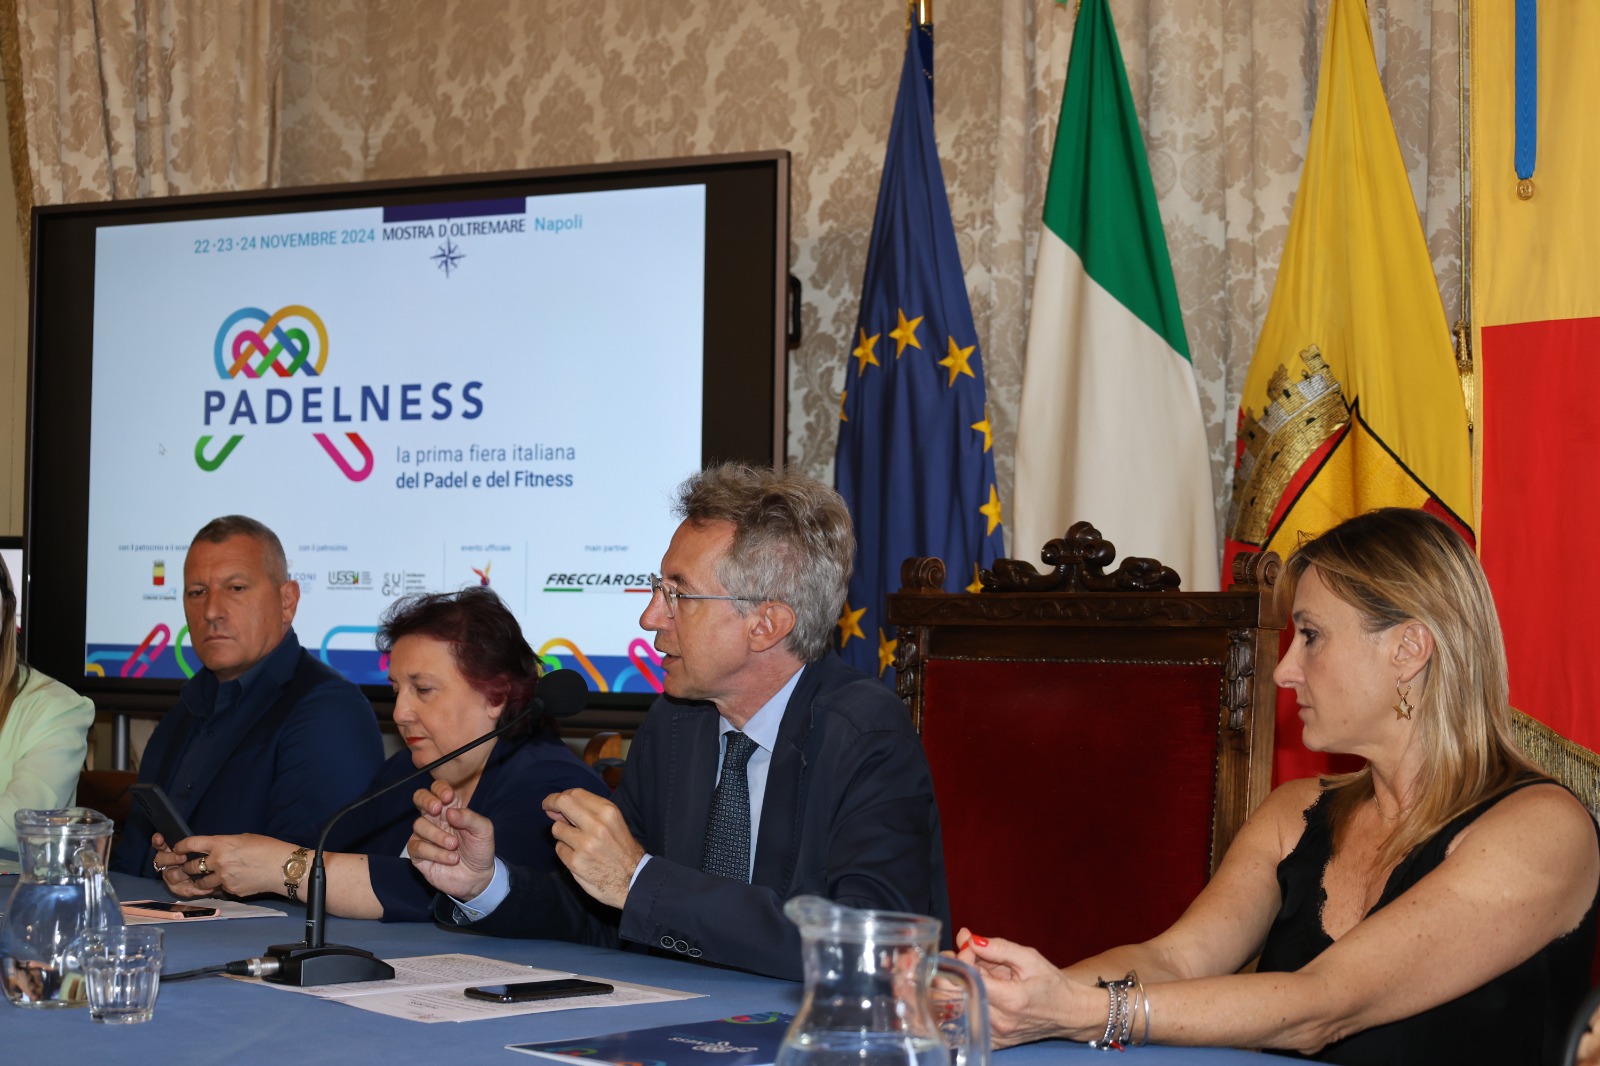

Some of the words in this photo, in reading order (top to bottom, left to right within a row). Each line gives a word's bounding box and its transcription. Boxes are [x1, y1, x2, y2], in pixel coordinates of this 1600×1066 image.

[382, 225, 434, 241] MOSTRA
[534, 214, 583, 234] Napoli
[260, 230, 337, 249] NOVEMBRE
[341, 228, 376, 245] 2024
[203, 381, 484, 426] PADELNESS
[396, 446, 410, 463] la
[416, 445, 464, 467] prima
[469, 444, 506, 462] fiera
[512, 444, 576, 462] italiana
[396, 472, 419, 489] del
[424, 471, 468, 488] Padel
[471, 477, 481, 488] e
[486, 471, 510, 488] del
[515, 471, 574, 488] Fitness
[546, 573, 652, 586] FRECCIAROSS
